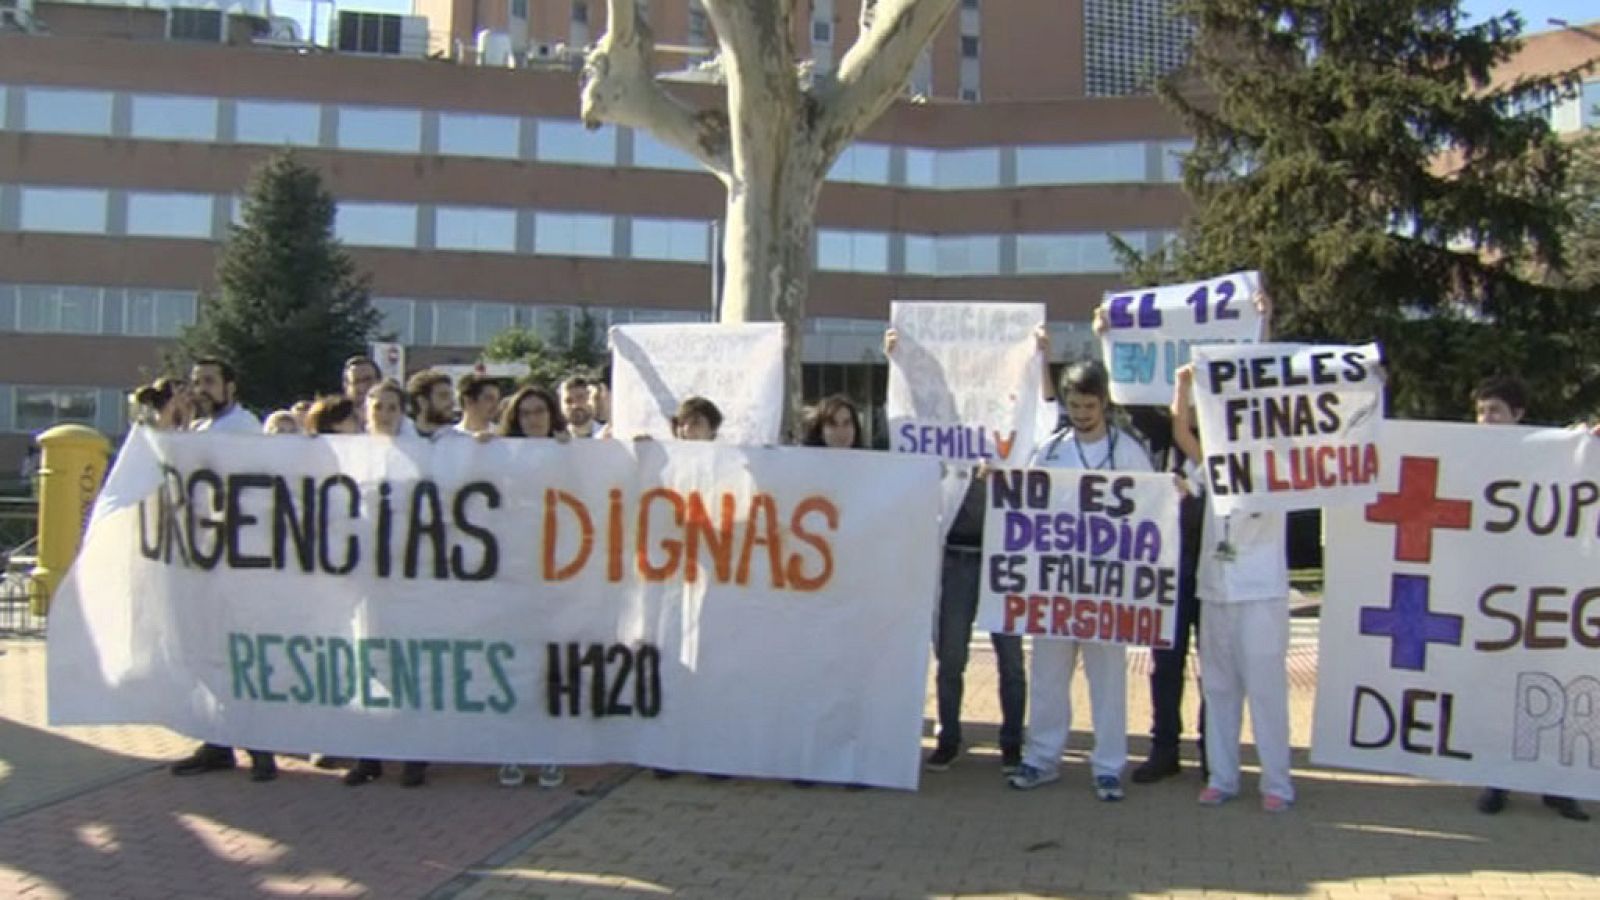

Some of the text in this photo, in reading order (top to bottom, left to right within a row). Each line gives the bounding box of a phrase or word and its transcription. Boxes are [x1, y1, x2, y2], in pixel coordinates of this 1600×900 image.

[1109, 280, 1240, 328] EL 12
[1208, 352, 1367, 395] PIELES
[1225, 392, 1340, 442] FINAS
[991, 468, 1135, 516] NO ES
[1207, 443, 1378, 494] EN LUCHA
[138, 465, 501, 582] URGENCIAS
[541, 487, 840, 592] DIGNAS
[1484, 480, 1600, 538] SUP
[1004, 512, 1161, 565] DESIDIA
[990, 554, 1176, 607] ES FALTA DE
[1002, 593, 1171, 648] PERSONAL
[228, 632, 517, 714] RESIDENTES
[1350, 684, 1472, 760] DEL
